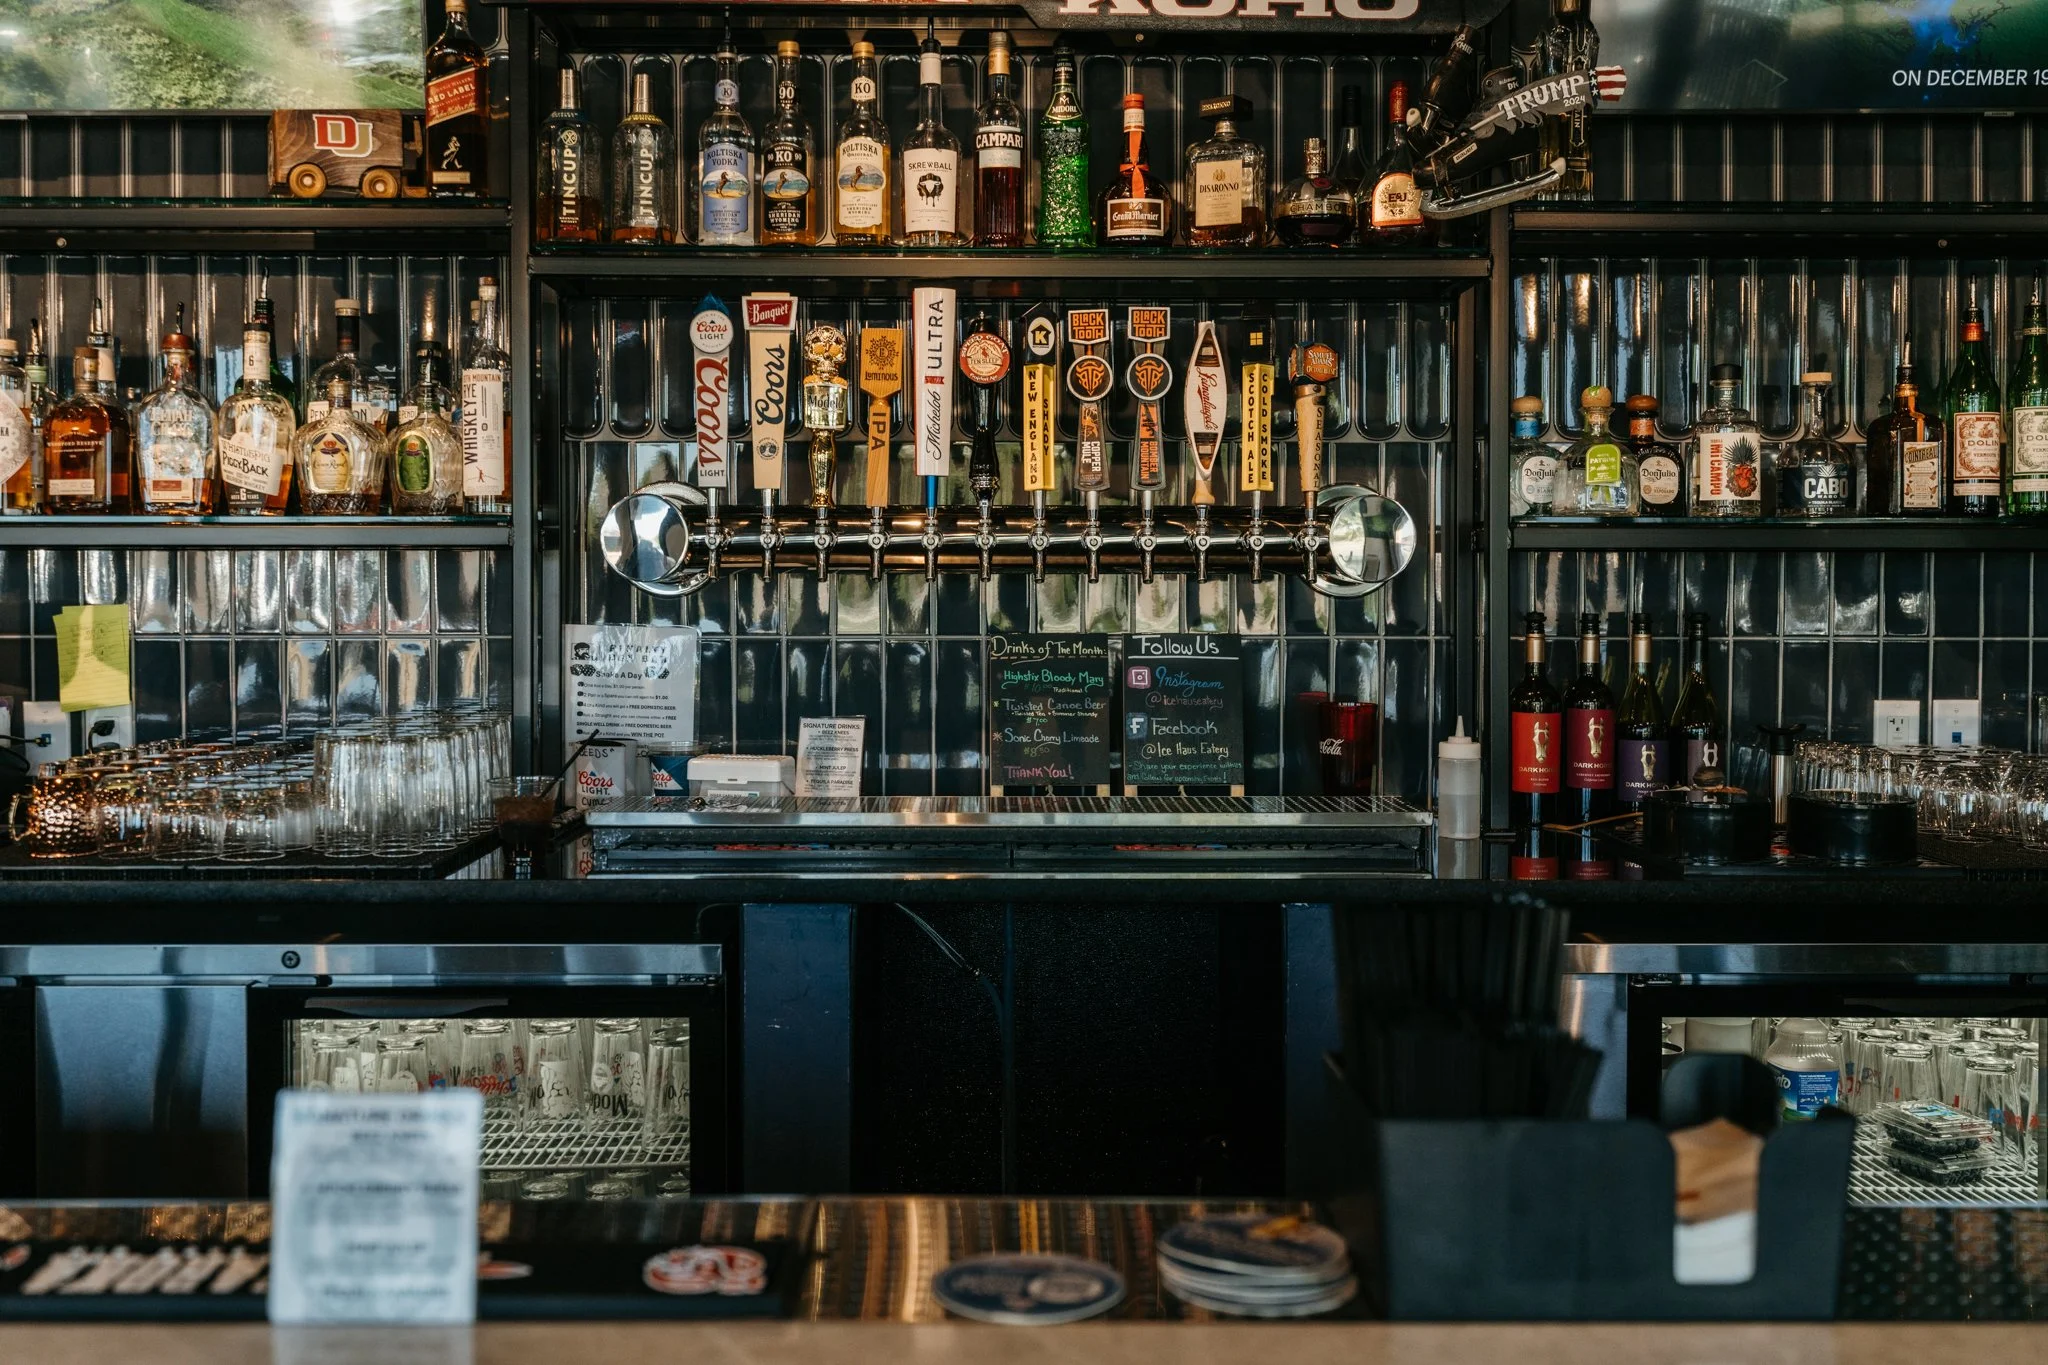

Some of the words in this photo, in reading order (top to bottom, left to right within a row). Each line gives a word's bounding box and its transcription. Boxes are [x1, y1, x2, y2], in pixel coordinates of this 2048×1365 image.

[1892, 70, 1921, 86] ON
[1927, 70, 2028, 86] DECEMBER
[428, 93, 446, 105] RED
[447, 83, 476, 98] LABEL
[779, 87, 795, 99] 90
[854, 83, 871, 94] KO
[1498, 74, 1585, 121] TRUMP
[1052, 105, 1077, 114] MIDORI
[1563, 95, 1586, 107] 2024
[842, 143, 878, 156] KOLTISKA
[976, 132, 1024, 149] CAMPARI
[707, 149, 743, 160] KOLTISKA
[712, 158, 738, 166] VODKA
[776, 151, 792, 162] KO
[908, 162, 953, 171] SKREWBALL
[563, 148, 577, 216] TINCUP
[640, 148, 654, 217] TINCUP
[1200, 182, 1239, 194] DISARONNO
[1387, 192, 1407, 203] E&J
[752, 303, 789, 324] Banquet
[1072, 312, 1104, 326] BLACK
[1133, 310, 1166, 324] BLACK
[696, 321, 728, 333] Coors
[927, 299, 944, 370] ULTRA
[1073, 327, 1104, 339] TOOTH
[1133, 324, 1166, 337] TOOTH
[1308, 350, 1333, 359] SAMUEL
[1311, 357, 1333, 367] ADAMS
[473, 374, 501, 382] MOUNTAIN
[755, 343, 786, 426] Coors
[1028, 370, 1038, 402] NEW
[809, 395, 845, 409] Modelo
[1247, 372, 1255, 442] SCOTCH
[696, 356, 728, 468] Coors
[464, 400, 478, 465] WHISKEY
[871, 412, 887, 450] IPA
[925, 389, 942, 461] Michelob
[1029, 409, 1038, 485] ENGLAND
[1081, 441, 1091, 464] MULE
[1260, 425, 1268, 480] SMOKE
[1313, 406, 1323, 488] SEASONAL
[1091, 441, 1102, 472] COPPER
[1140, 441, 1150, 480] MOUNTAIN
[1149, 441, 1159, 473] BOMBER
[1247, 451, 1255, 484] ALE
[1525, 469, 1541, 477] Don
[1641, 469, 1657, 477] Don
[1655, 469, 1676, 480] Julio
[1710, 460, 1723, 496] CAMPO
[240, 489, 246, 500] 6
[1804, 478, 1849, 499] CABO
[991, 635, 1036, 656] Drinks
[1052, 641, 1071, 655] The
[1072, 641, 1107, 655] Month:
[1132, 635, 1193, 655] Follow
[1195, 635, 1220, 654] Us
[628, 672, 643, 681] Day
[1002, 670, 1039, 689] Highstix
[1041, 669, 1076, 685] Bloody
[1079, 671, 1104, 692] Mary
[1155, 666, 1225, 697] Instagram
[1001, 698, 1044, 711] Twisted
[1047, 697, 1083, 710] Canoe
[1084, 697, 1106, 710] Beer
[1004, 728, 1032, 743] Sonic
[1063, 731, 1100, 743] Limeade
[1150, 717, 1218, 736] Facebook
[1141, 741, 1173, 759] @Ice
[1176, 741, 1197, 755] Haus
[1200, 742, 1229, 760] Eatery
[578, 770, 614, 787] Coors
